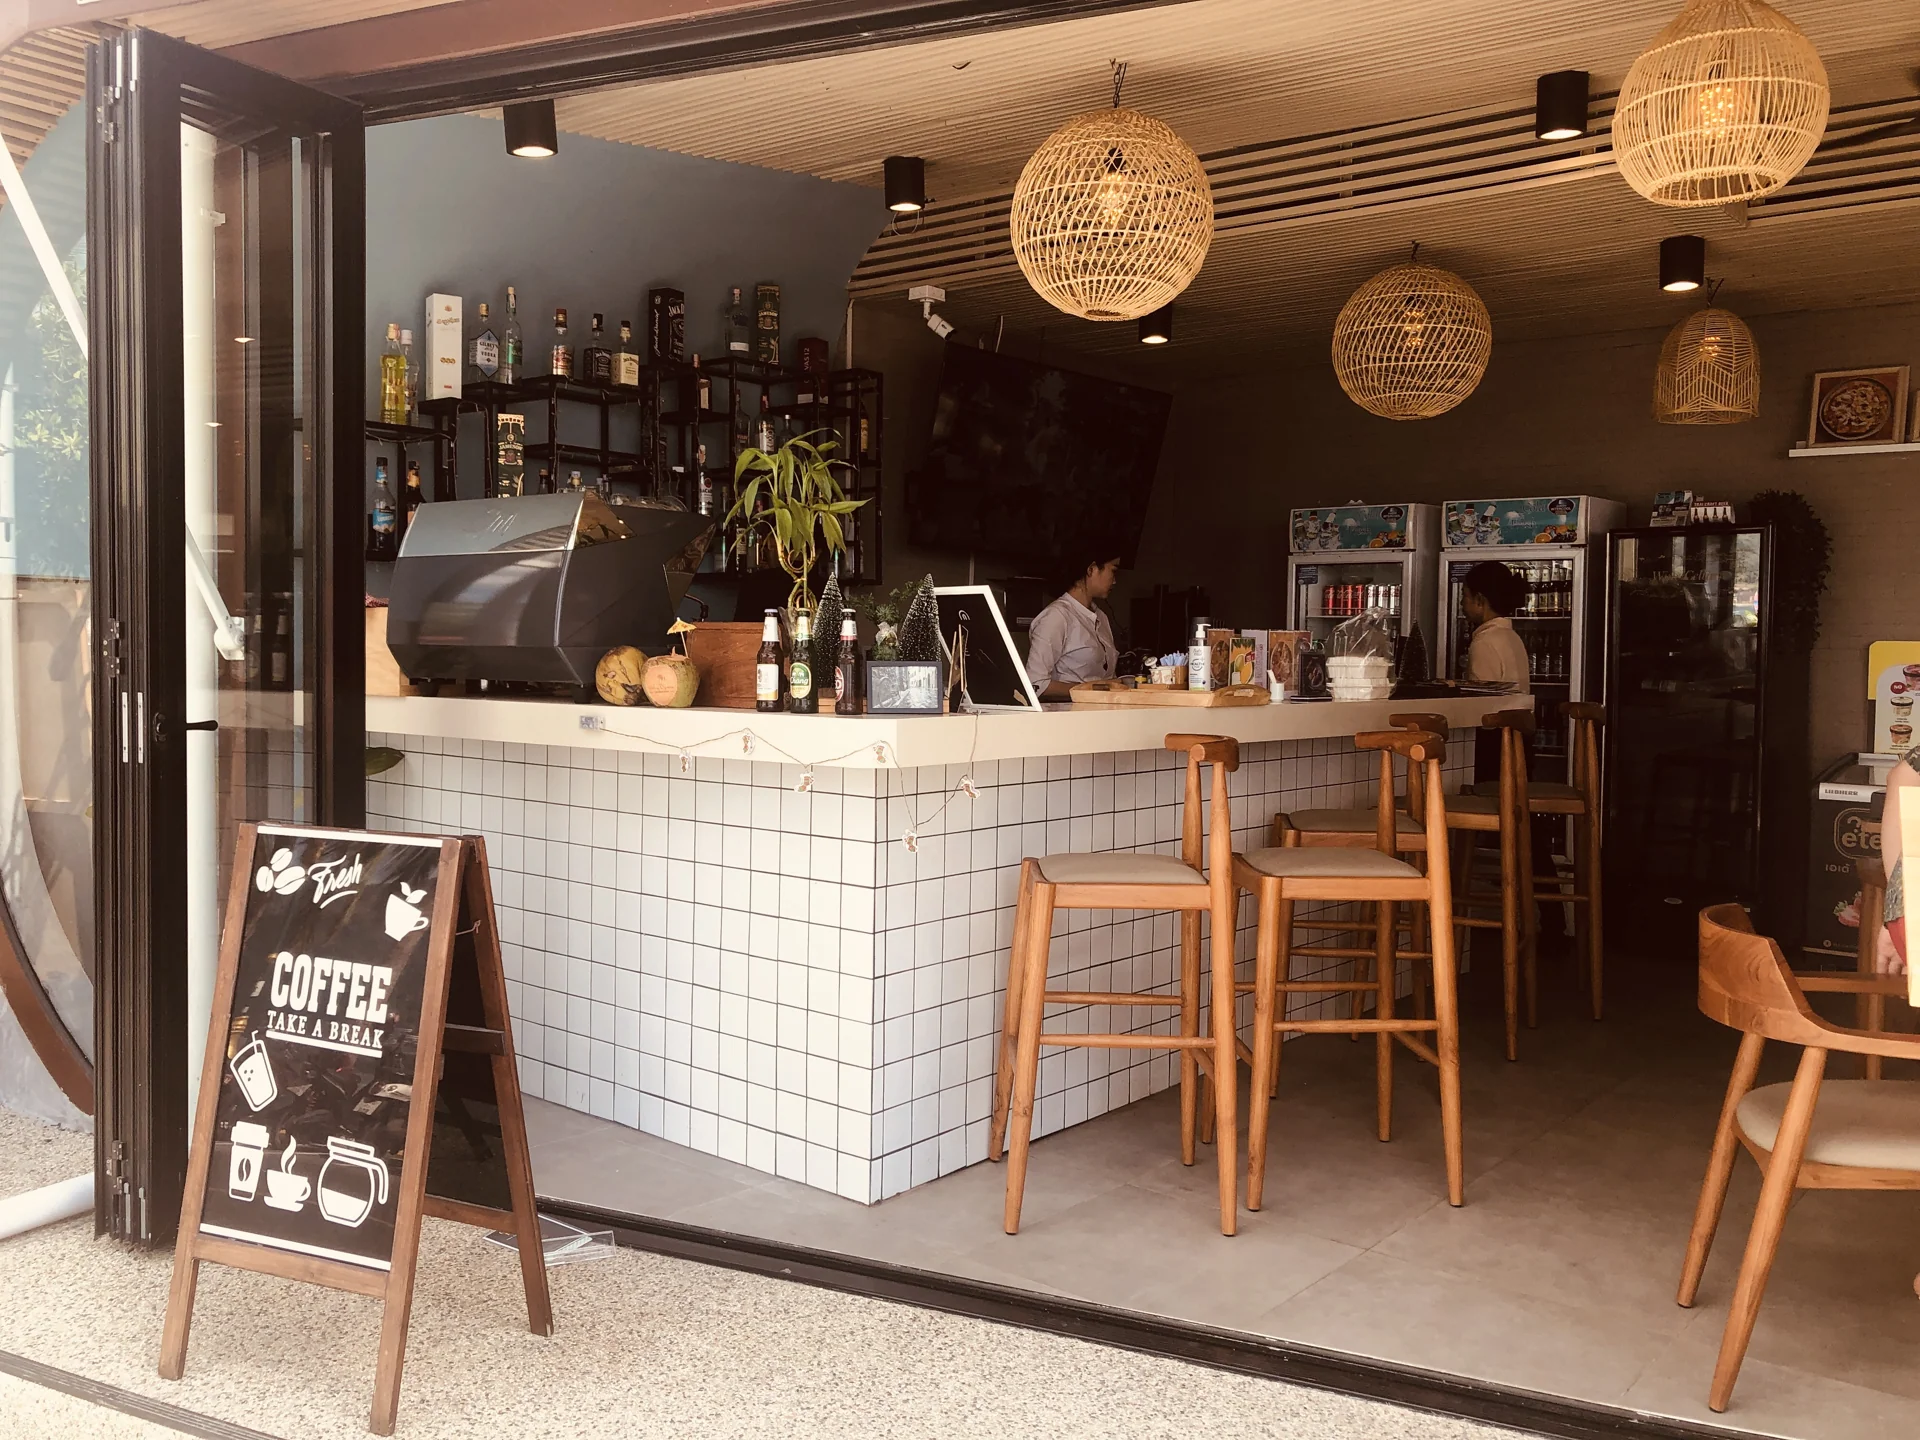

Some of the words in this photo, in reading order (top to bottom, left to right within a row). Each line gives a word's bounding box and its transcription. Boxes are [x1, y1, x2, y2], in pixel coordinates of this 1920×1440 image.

[498, 443, 523, 451] JAMESON
[790, 676, 809, 686] Chang
[307, 853, 363, 904] Fresh
[270, 951, 393, 1024] COFFEE
[267, 1010, 308, 1035] TAKE
[311, 1018, 323, 1038] A
[328, 1021, 385, 1049] BREAK
